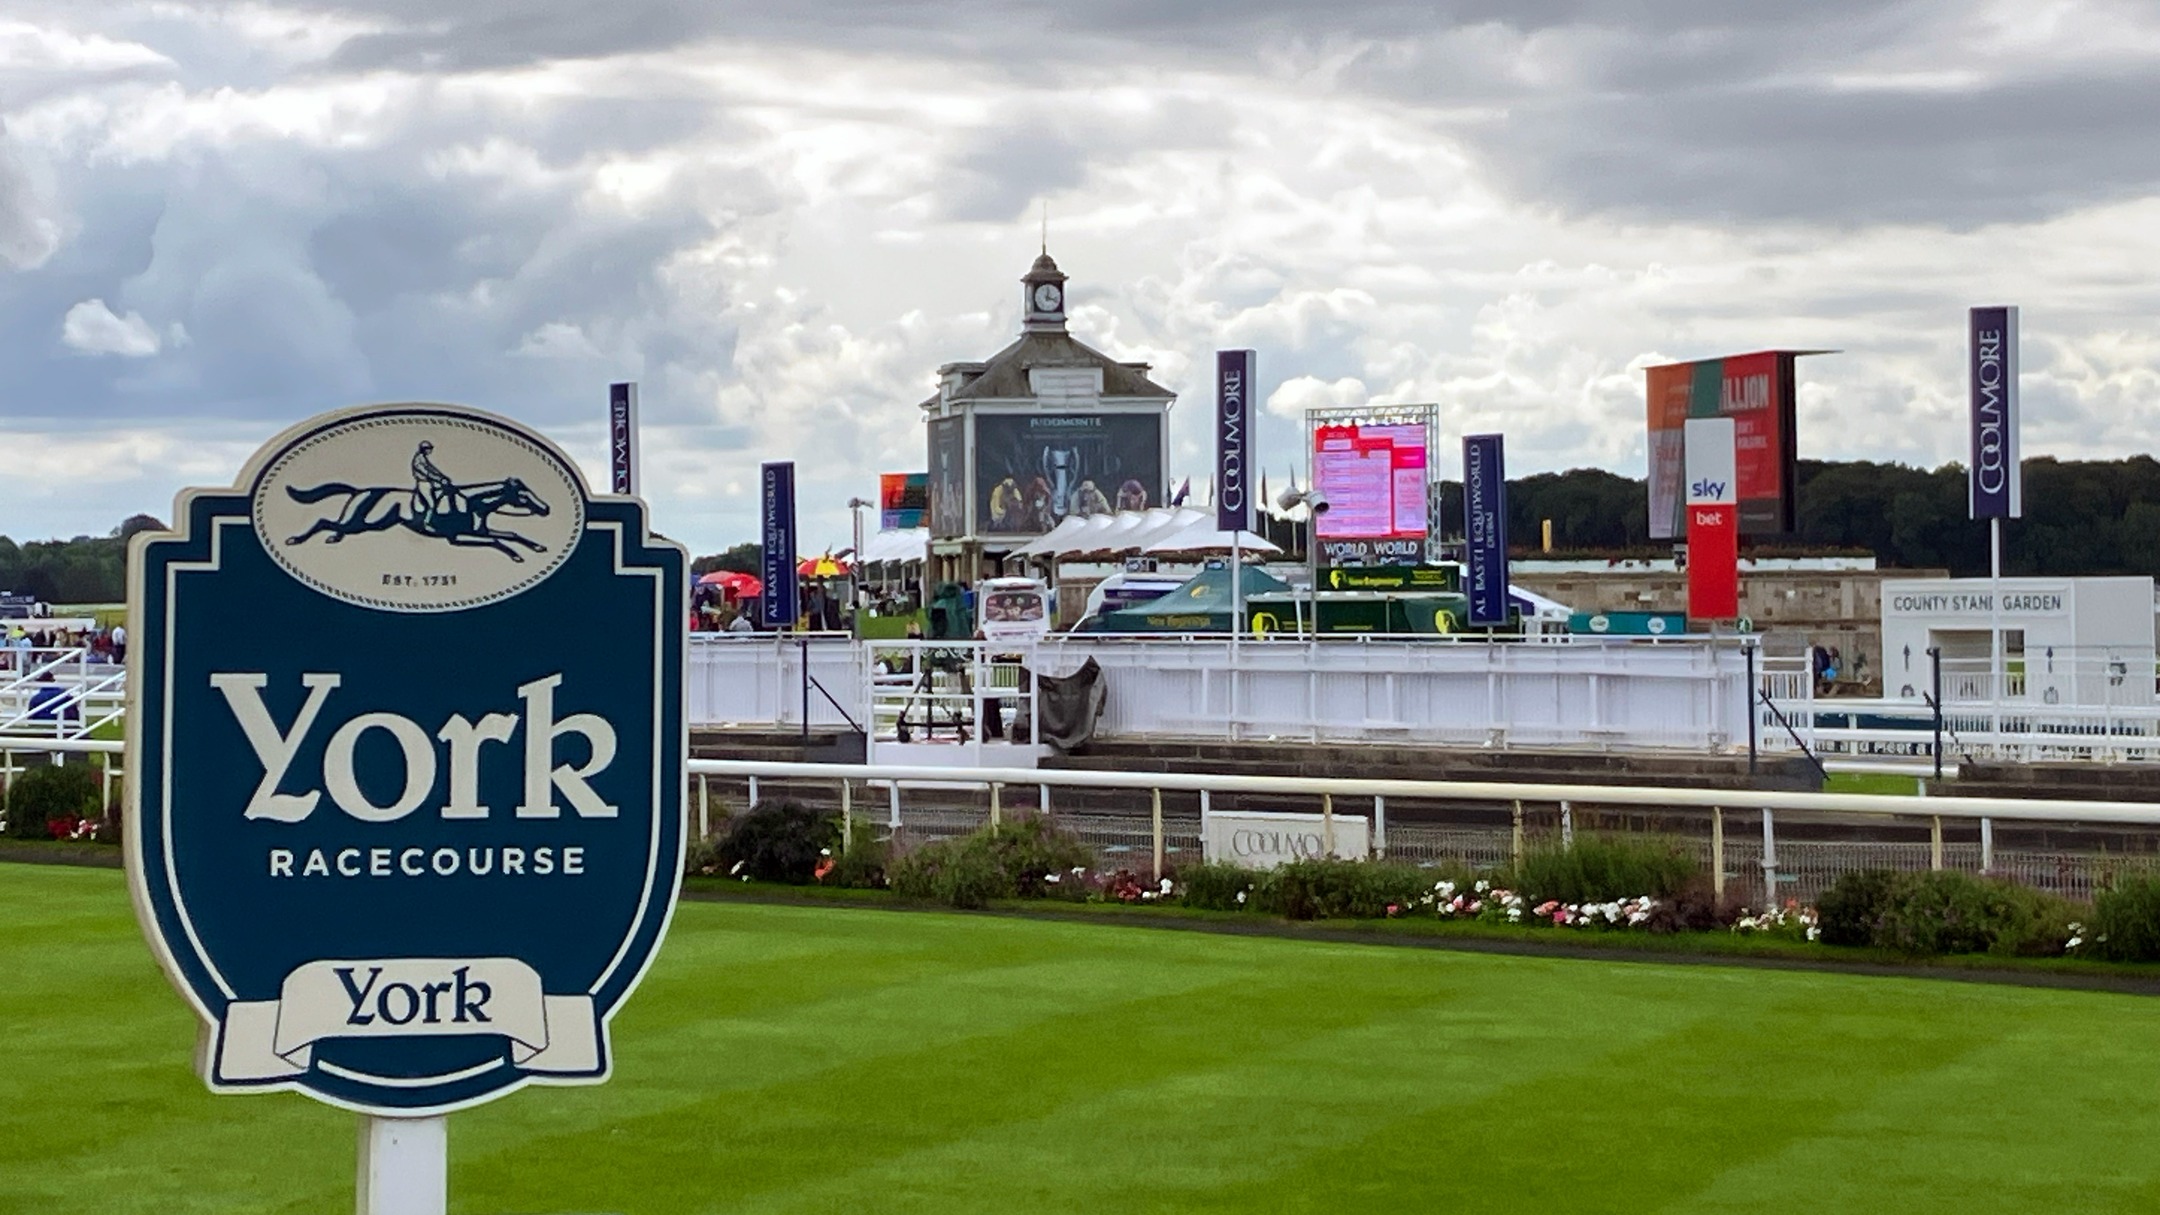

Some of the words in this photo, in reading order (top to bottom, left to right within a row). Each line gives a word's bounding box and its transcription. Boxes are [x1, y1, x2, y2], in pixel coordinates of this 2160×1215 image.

[1979, 329, 2005, 494] COOLMORE
[1222, 370, 1243, 511] COOLMORE
[1470, 444, 1485, 543] EQUIWORLD
[1692, 478, 1726, 500] sky
[1696, 512, 1723, 526] bet
[1323, 541, 1368, 557] WORLD
[1373, 540, 1418, 556] WORLD
[1474, 549, 1486, 591] BASTI
[768, 600, 778, 618] AL
[1476, 598, 1486, 616] AL
[1893, 595, 1948, 612] COUNTY
[2003, 595, 2061, 610] GARDEN
[210, 673, 619, 823] York
[269, 847, 586, 877] RACECOURSE
[333, 965, 492, 1026] York
